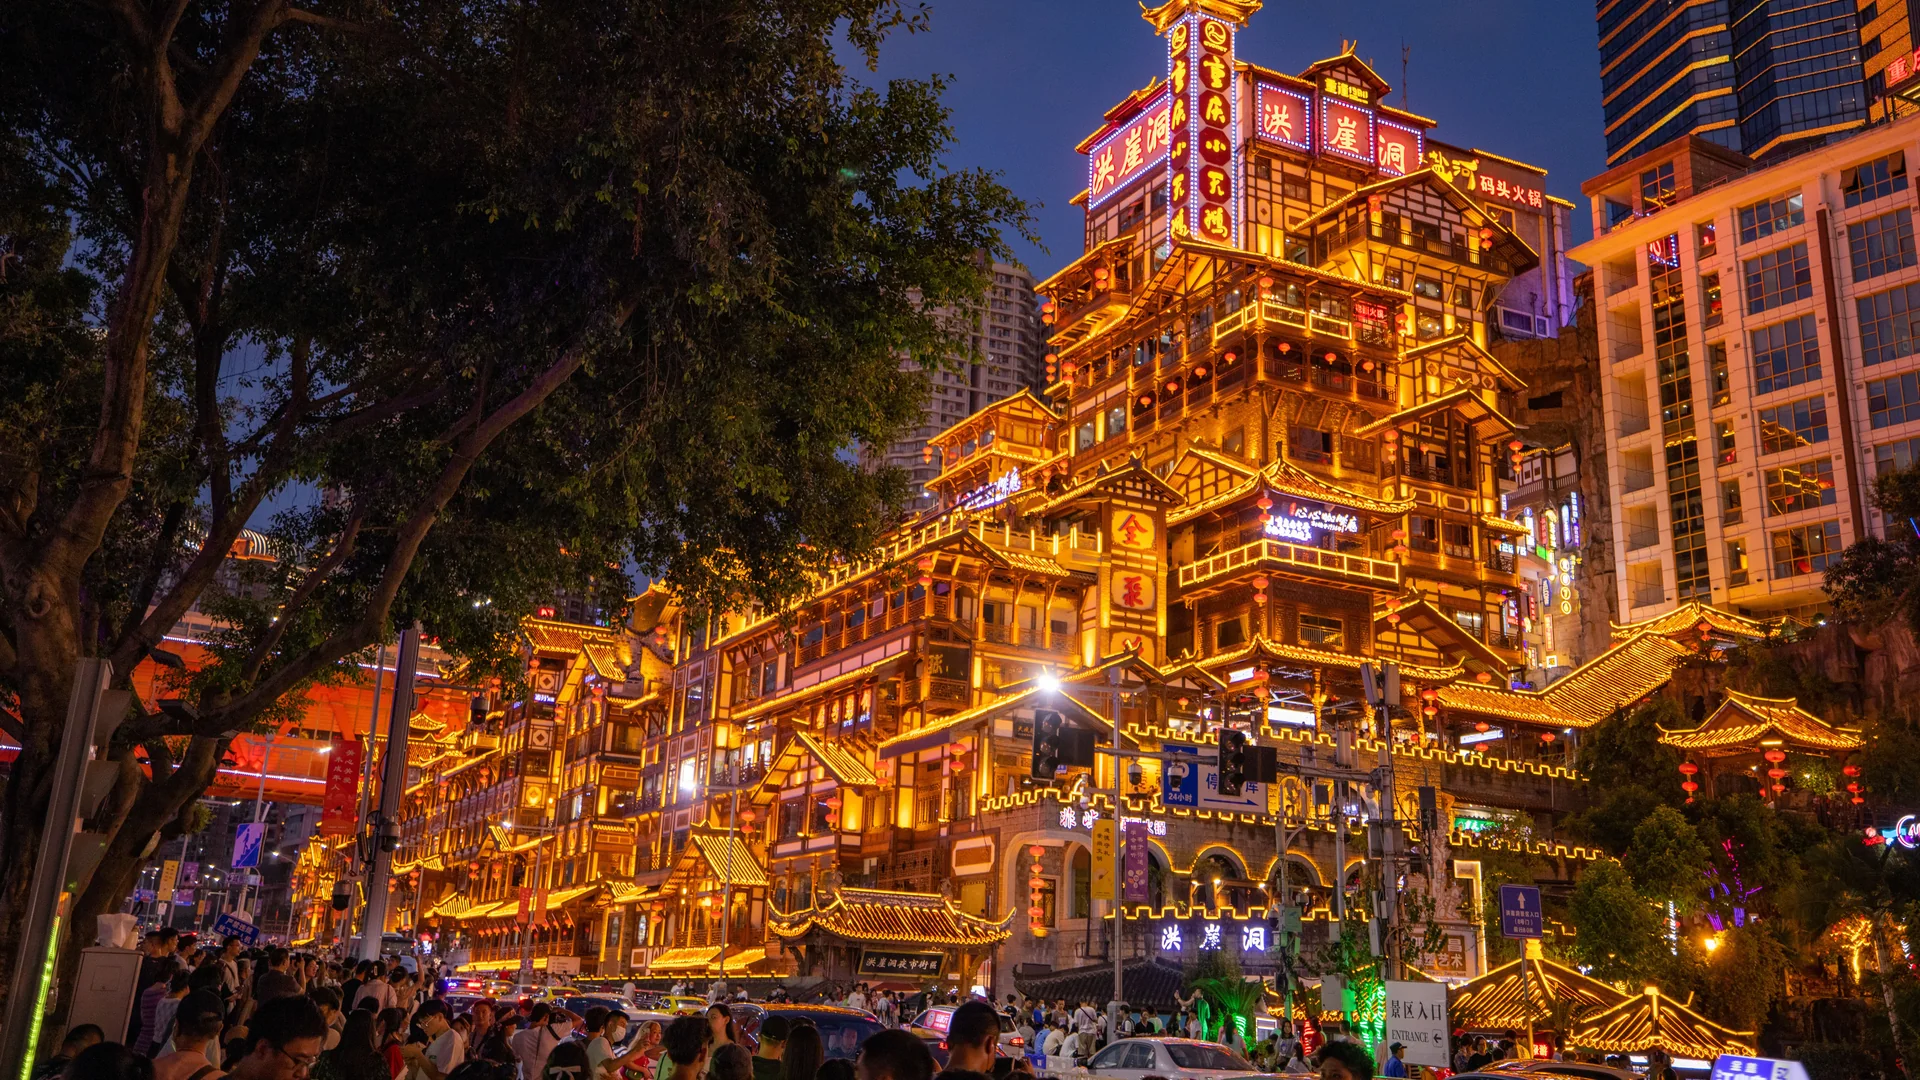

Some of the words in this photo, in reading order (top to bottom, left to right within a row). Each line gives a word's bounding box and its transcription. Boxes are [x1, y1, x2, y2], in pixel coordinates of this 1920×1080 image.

[1092, 107, 1170, 195] 洪崖洞
[1171, 60, 1189, 237] 重庆小天鹅
[1203, 56, 1228, 237] 重庆小天鹅
[1264, 103, 1405, 174] 洪崖洞
[1480, 175, 1542, 208] 码头火锅
[331, 756, 343, 791] 未成年人
[1206, 773, 1259, 794] 停库
[1168, 792, 1193, 803] 24小时
[1162, 923, 1265, 951] 洪崖洞
[1391, 1000, 1442, 1020] 景区入口
[1391, 1029, 1429, 1043] ENTRANCE
